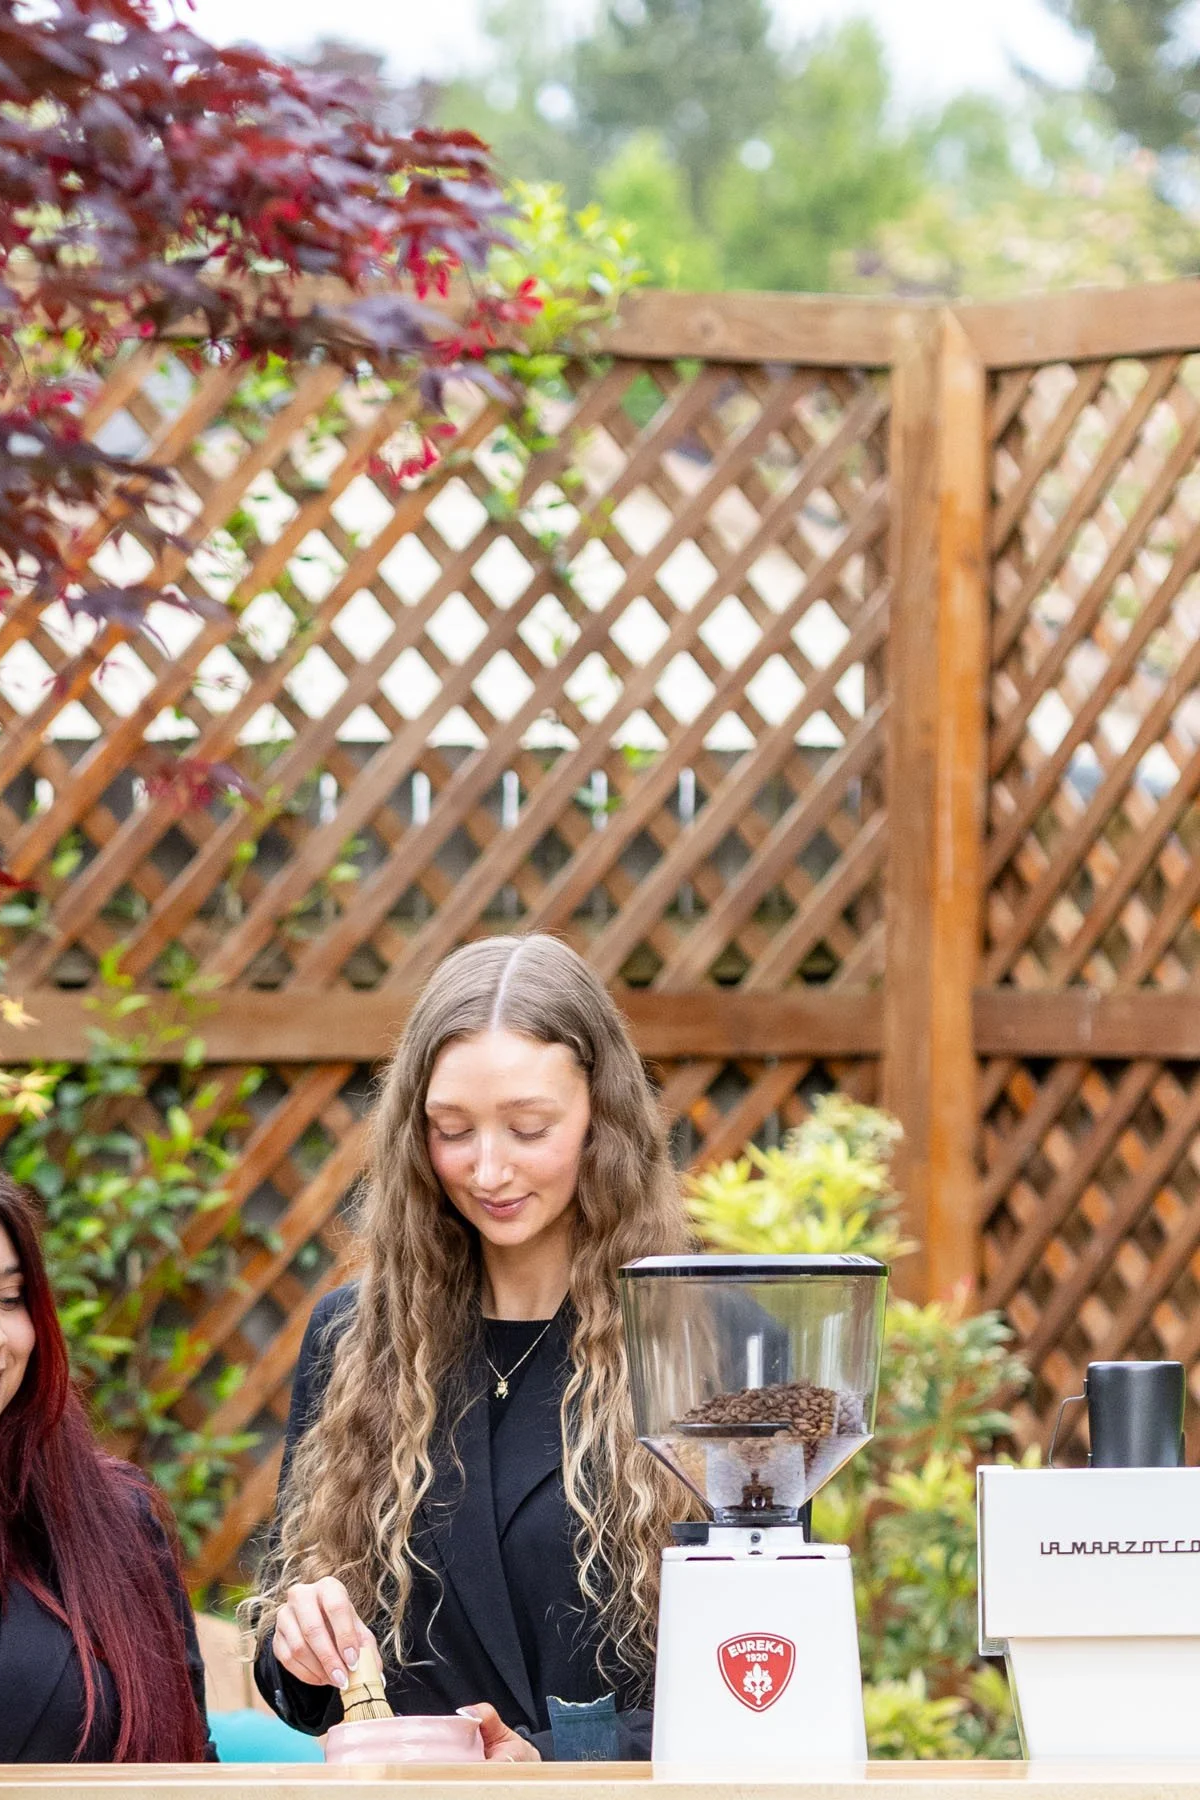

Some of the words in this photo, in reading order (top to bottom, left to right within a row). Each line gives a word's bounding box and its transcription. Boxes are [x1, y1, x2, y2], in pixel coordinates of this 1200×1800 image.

[1040, 1541, 1060, 1555] LA
[727, 1640, 784, 1658] EUREKA
[745, 1653, 769, 1663] 1920
